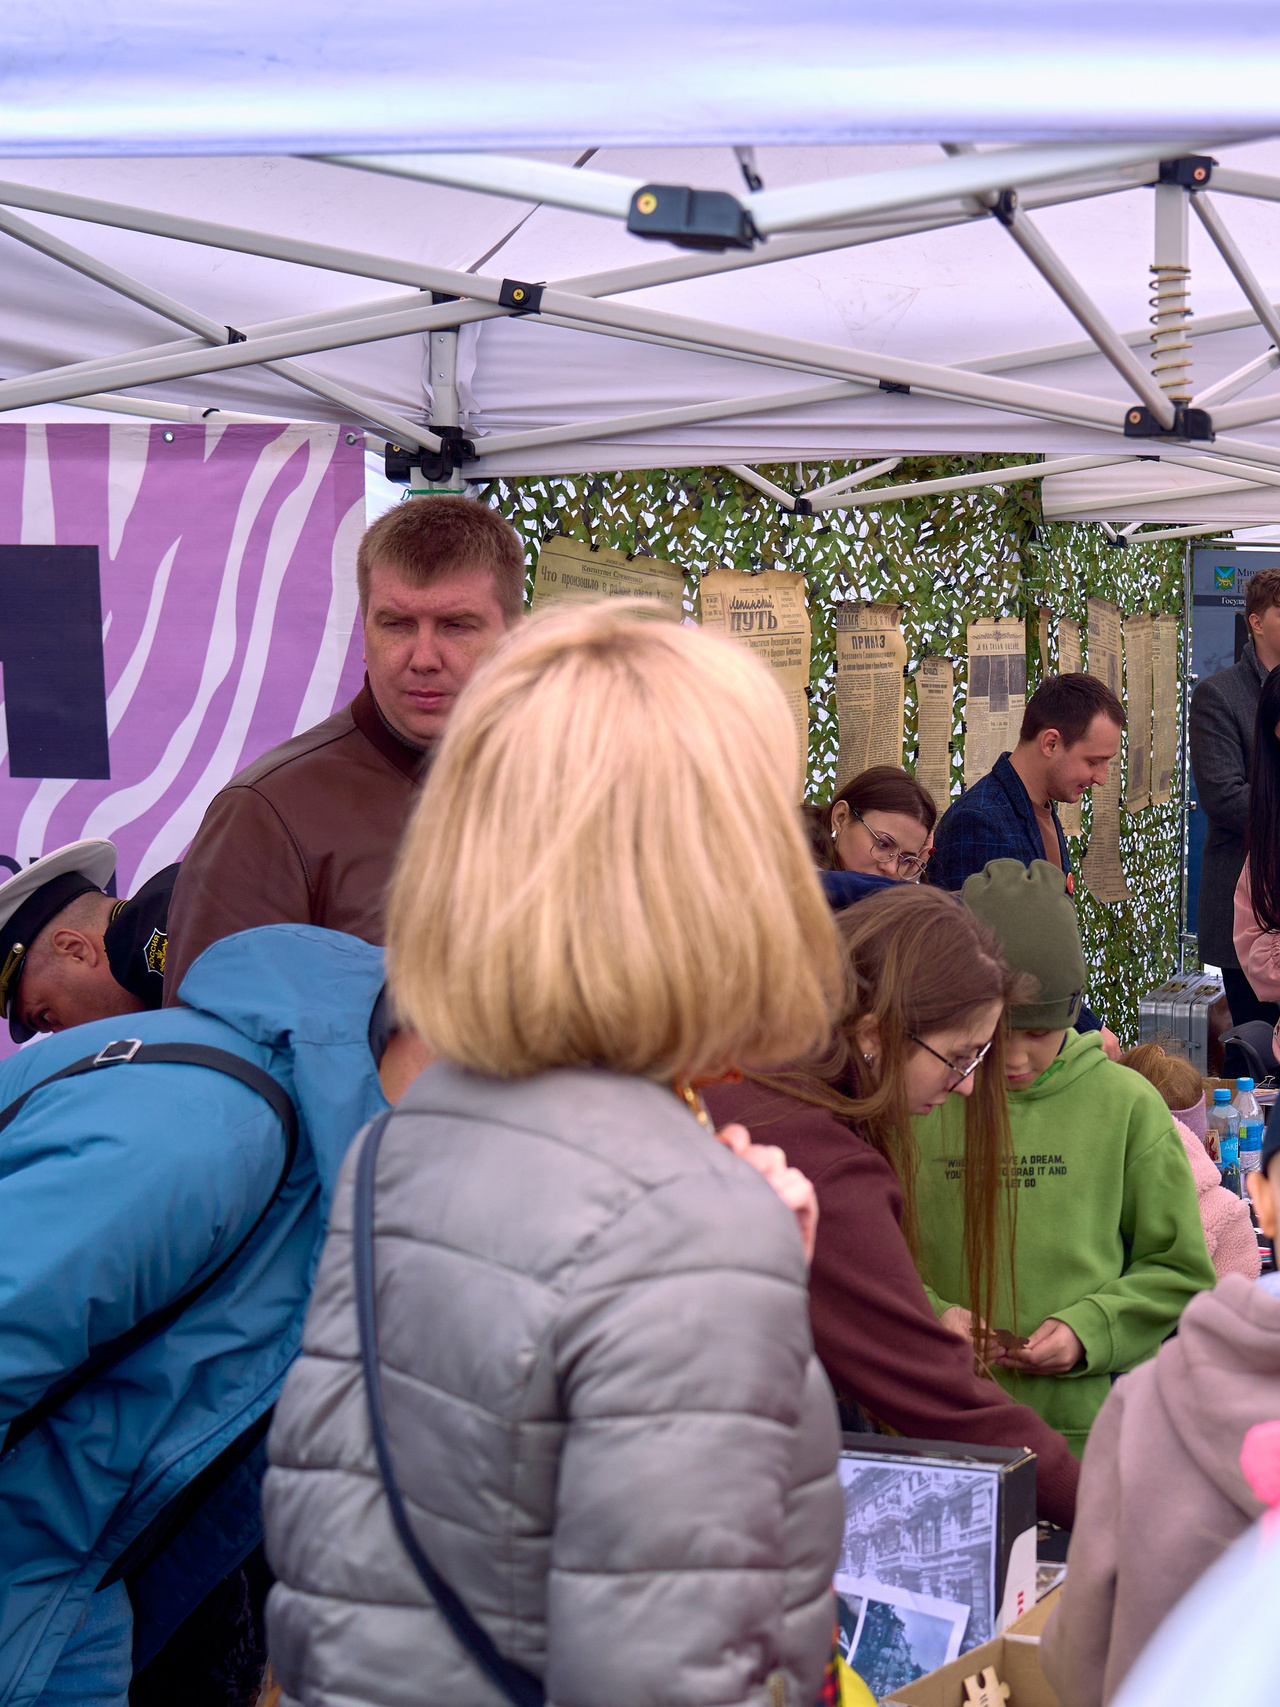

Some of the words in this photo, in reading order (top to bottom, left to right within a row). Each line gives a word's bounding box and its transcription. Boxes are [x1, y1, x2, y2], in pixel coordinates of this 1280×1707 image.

[541, 565, 557, 582] Что
[561, 573, 599, 591] произошло
[730, 610, 778, 632] ПУТЬ
[149, 934, 161, 969] РОССИЯ
[1020, 1156, 1027, 1165] A
[1030, 1154, 1065, 1165] DREAM,
[1037, 1166, 1045, 1176] IT
[1048, 1166, 1067, 1176] AND
[1024, 1178, 1036, 1188] GO
